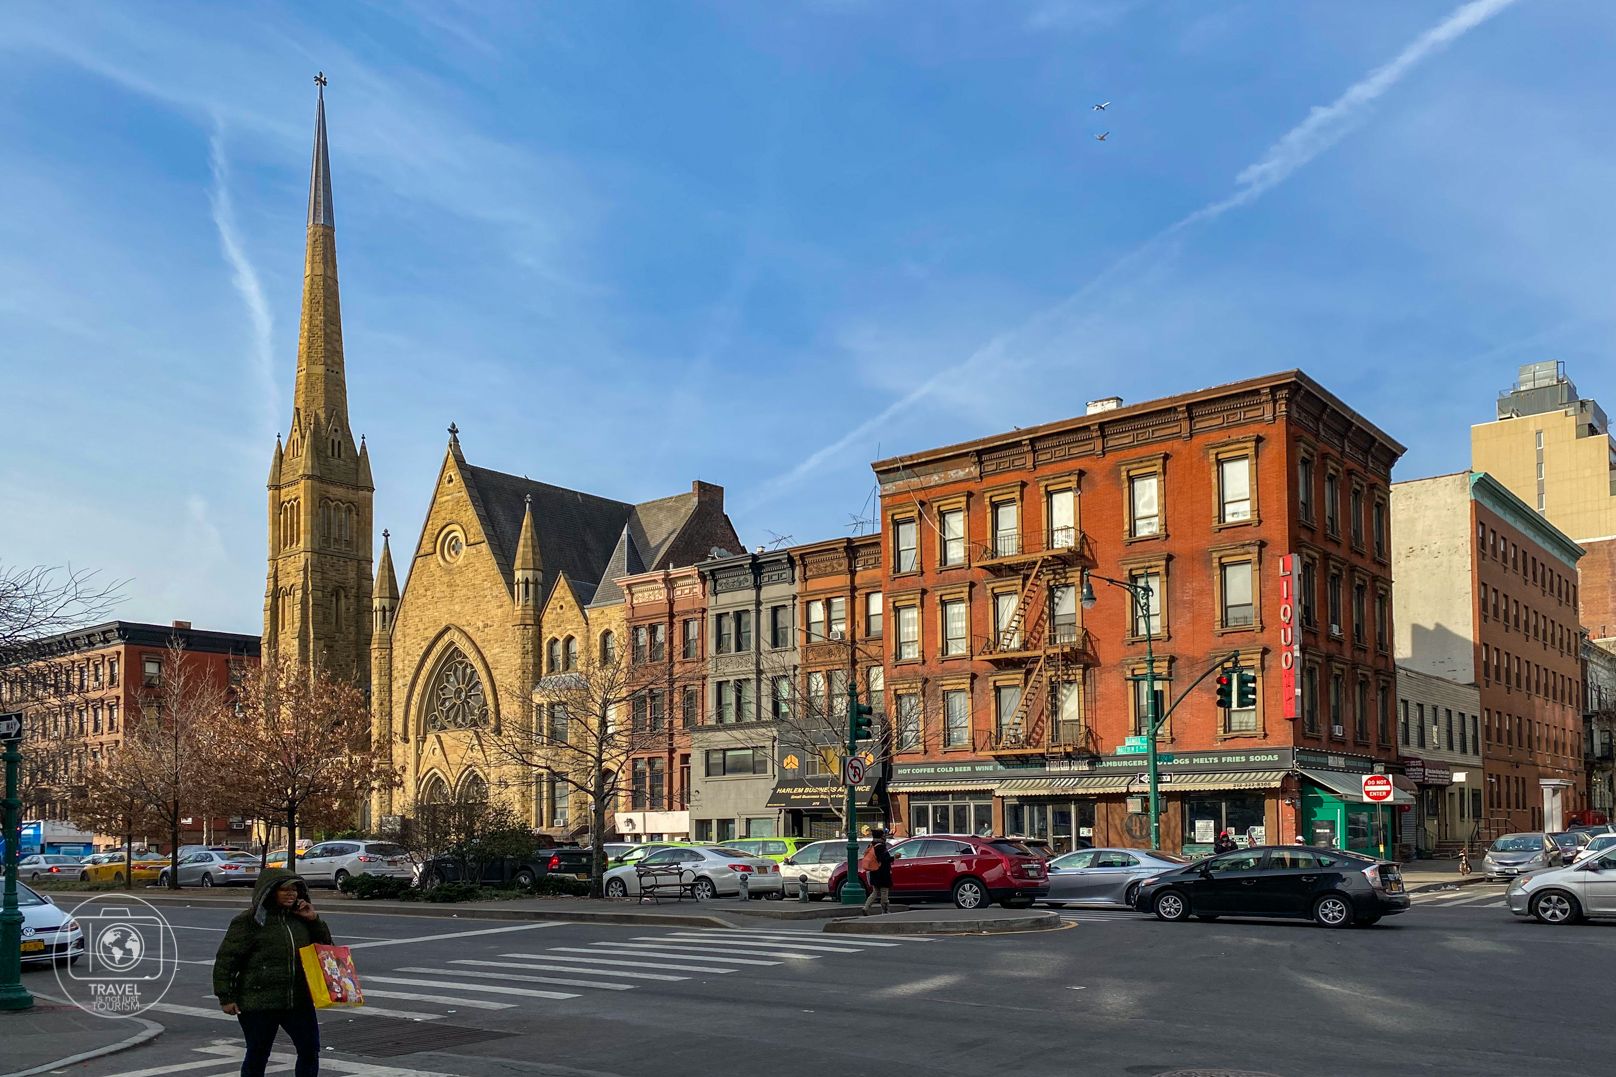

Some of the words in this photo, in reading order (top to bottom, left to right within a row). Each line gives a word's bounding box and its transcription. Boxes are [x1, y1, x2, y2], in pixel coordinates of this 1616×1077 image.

[1279, 556, 1293, 670] LIQUO
[1096, 760, 1148, 768] HAMBURGERS
[1249, 754, 1279, 762] SODAS
